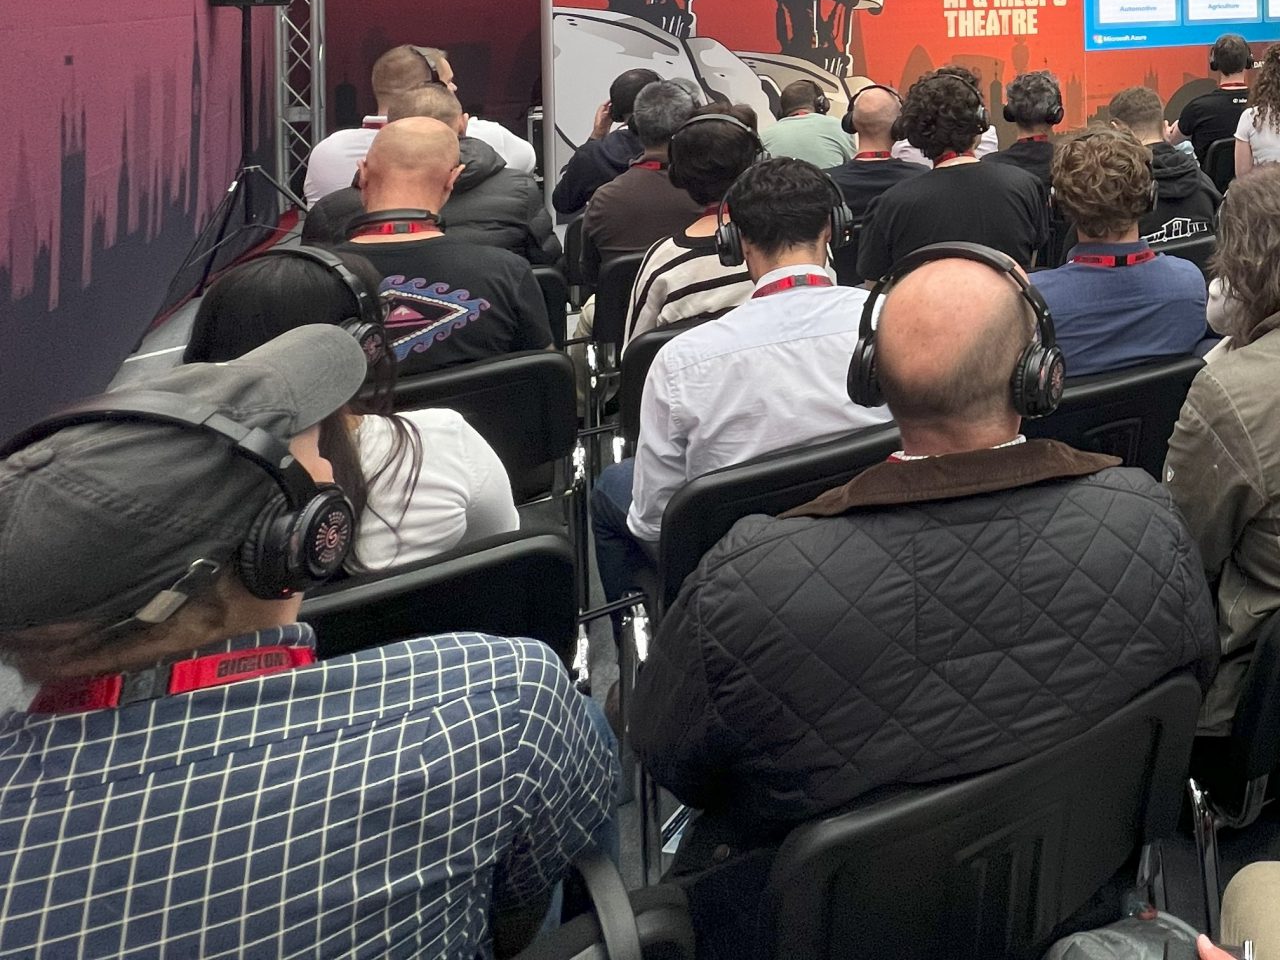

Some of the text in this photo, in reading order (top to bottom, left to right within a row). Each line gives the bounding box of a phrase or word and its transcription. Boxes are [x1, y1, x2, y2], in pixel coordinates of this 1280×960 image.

[1207, 3, 1240, 11] Agriculture
[943, 8, 1039, 38] THEATRE
[1103, 34, 1130, 42] Microsoft
